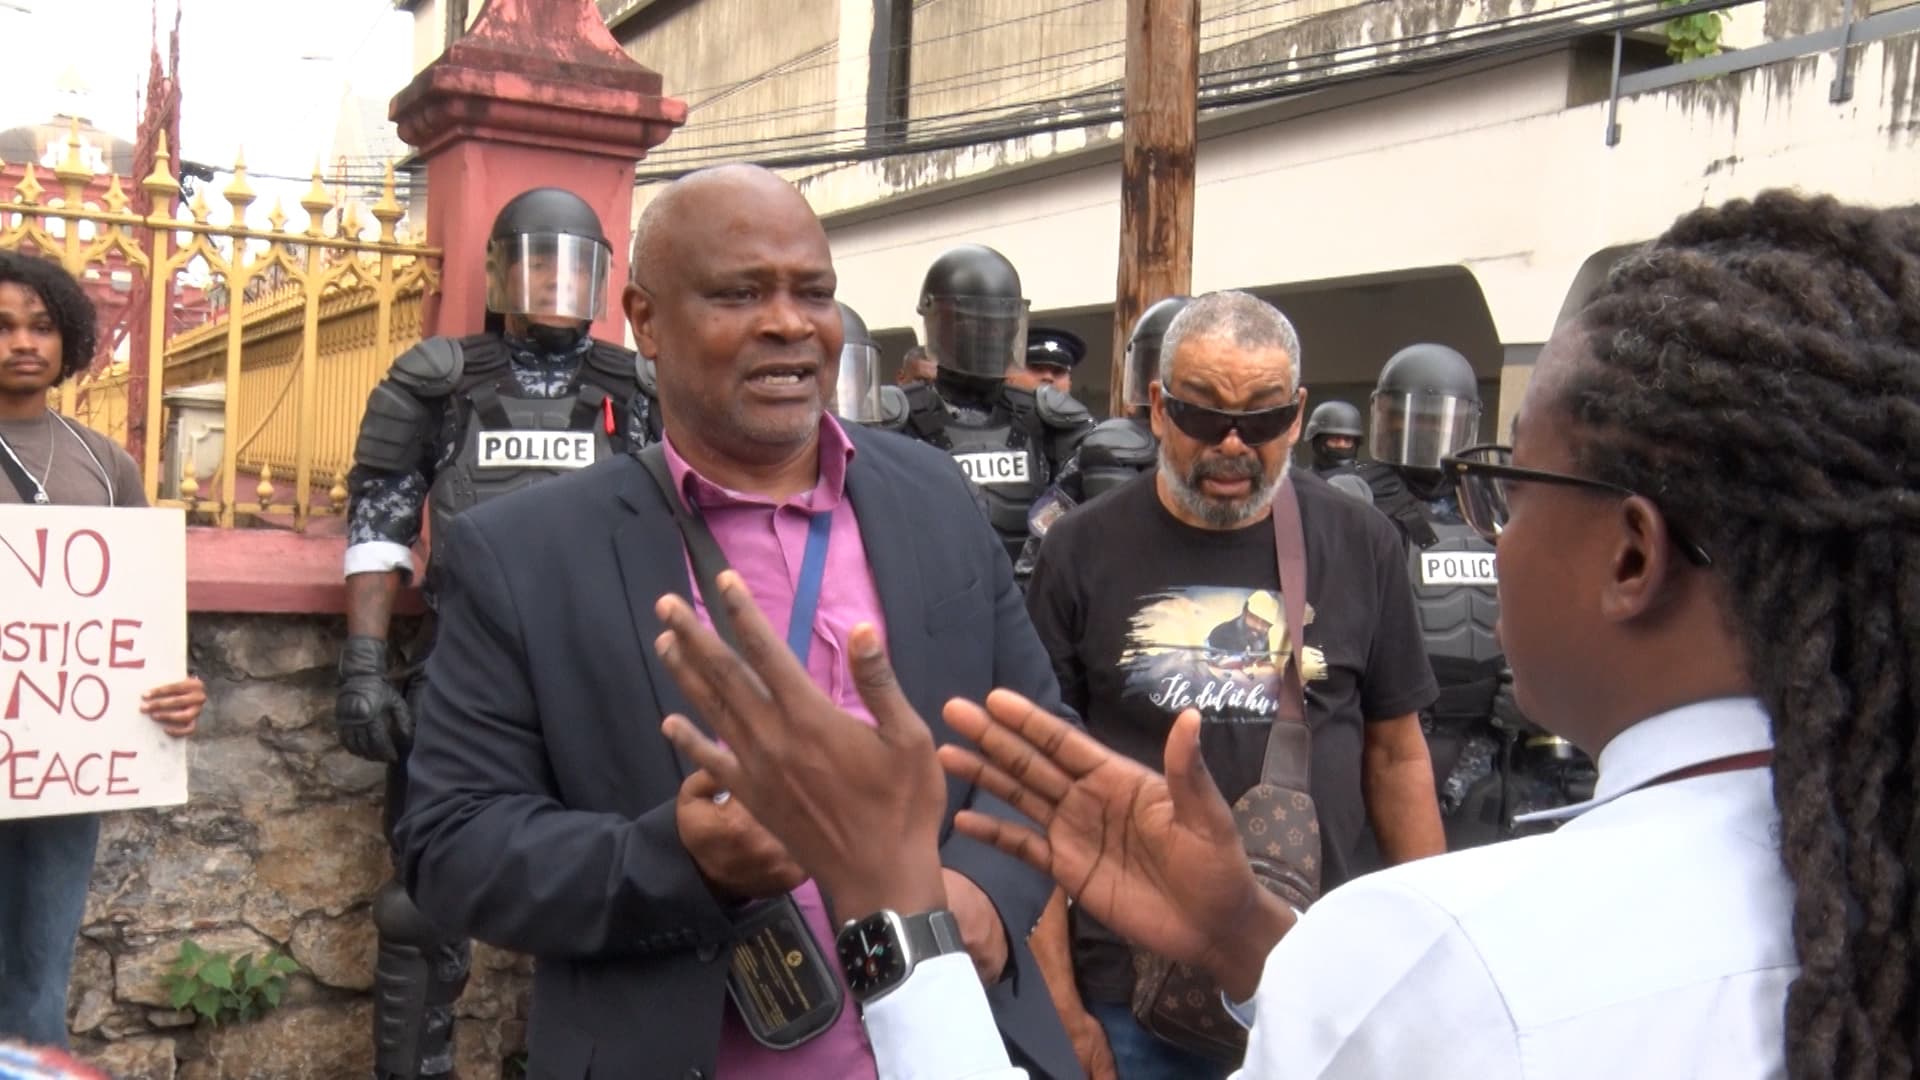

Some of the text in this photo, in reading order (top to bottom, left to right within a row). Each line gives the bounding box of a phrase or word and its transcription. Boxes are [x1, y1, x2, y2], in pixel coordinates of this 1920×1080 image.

[485, 437, 588, 461] POLICE
[959, 456, 1025, 478] OLICE
[1427, 558, 1497, 578] POLIC
[0, 619, 145, 669] STICE
[4, 670, 110, 722] NO
[1195, 681, 1235, 711] did
